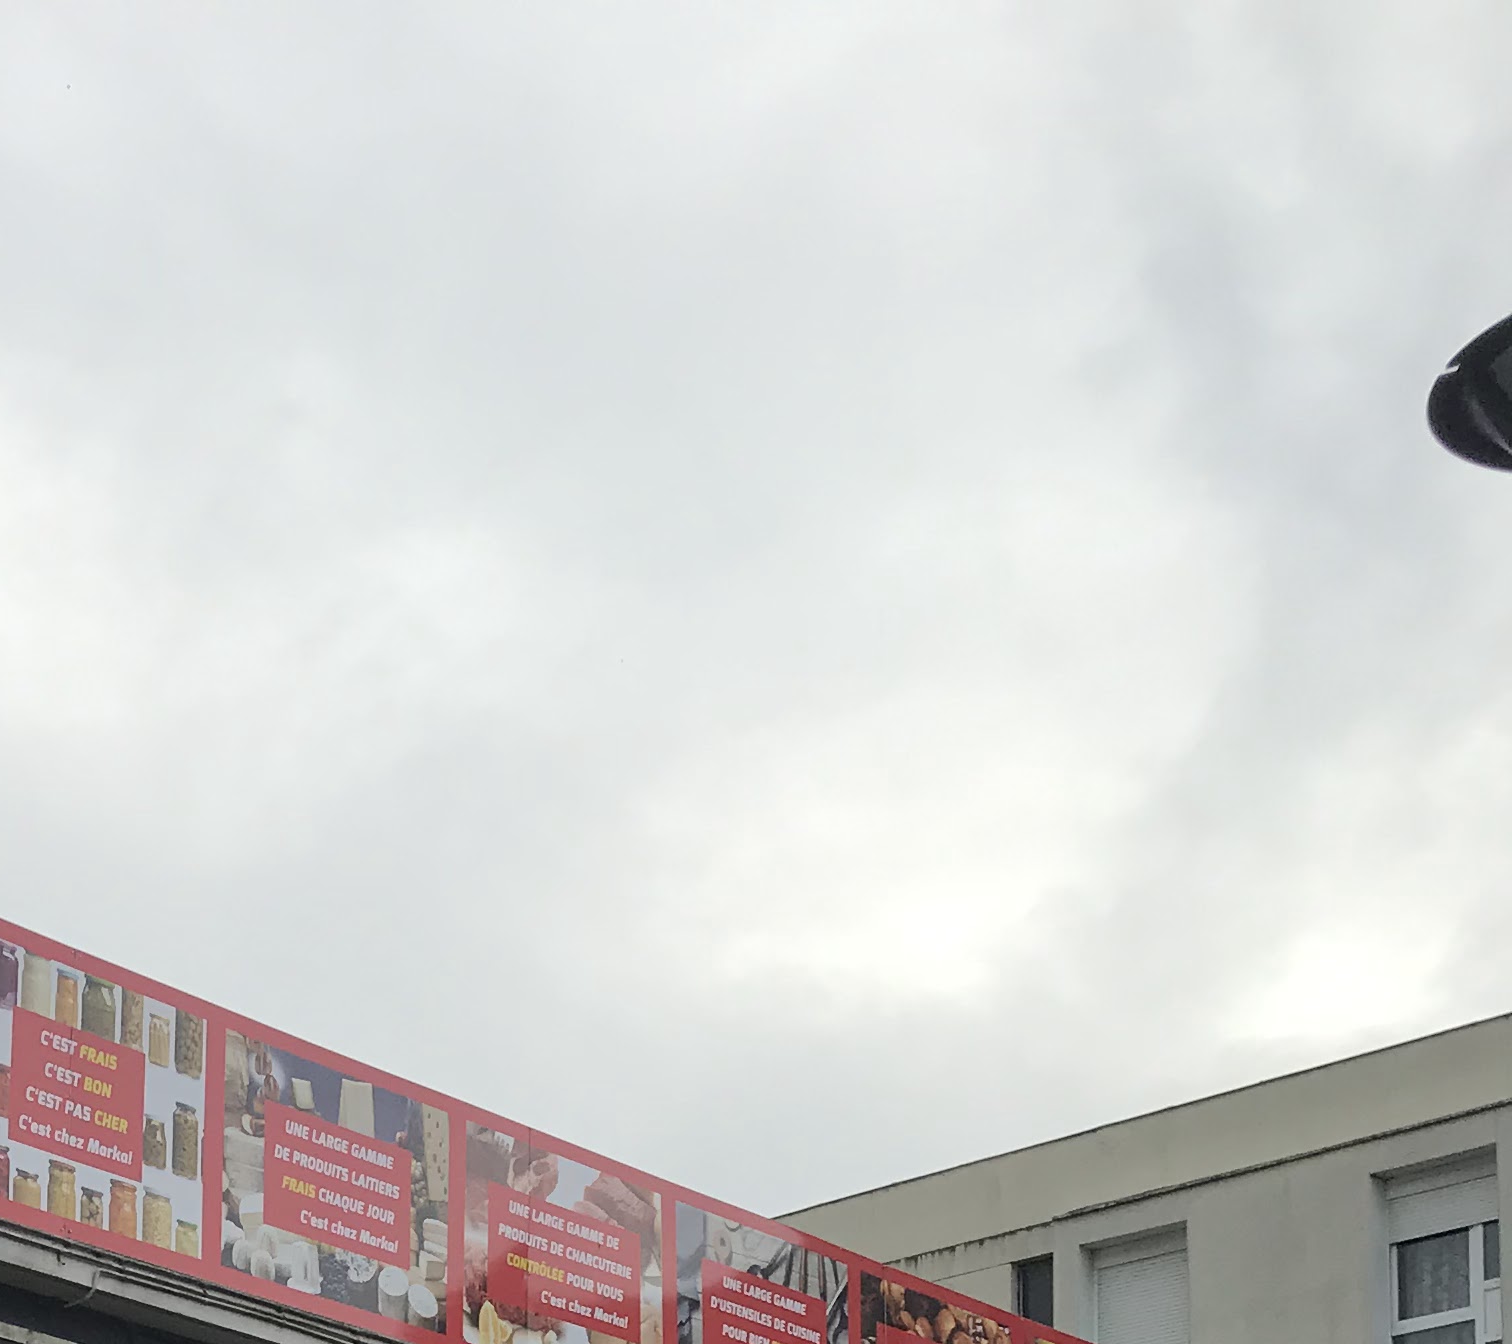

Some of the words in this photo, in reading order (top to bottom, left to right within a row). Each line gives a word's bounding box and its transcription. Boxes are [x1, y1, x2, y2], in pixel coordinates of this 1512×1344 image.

[41, 1031, 77, 1055] C'EST
[80, 1045, 118, 1070] FRAIS
[45, 1063, 81, 1087] C'EST
[84, 1077, 112, 1098] BON
[26, 1086, 63, 1110] C'EST
[65, 1100, 91, 1121] PAS
[94, 1110, 128, 1134] CHER
[19, 1115, 51, 1138] C'est
[55, 1128, 84, 1149] chez
[286, 1120, 309, 1140] UNE
[312, 1129, 349, 1154] LARGE
[351, 1144, 394, 1169] GAMME
[275, 1144, 290, 1161] DE
[293, 1151, 349, 1182] PRODUITS
[352, 1171, 400, 1199] LAITIERS
[282, 1176, 316, 1198] FRAIS
[319, 1188, 365, 1215] CHAQUE
[367, 1204, 395, 1225] JOUR
[301, 1210, 328, 1231] C'est
[331, 1221, 357, 1241] chez
[509, 1200, 530, 1219] UNE
[532, 1209, 564, 1231] LARGE
[567, 1222, 604, 1245] GAMME
[607, 1235, 619, 1250] DE
[498, 1223, 548, 1251] PRODUITS
[550, 1242, 564, 1257] DE
[566, 1247, 632, 1280] CHARCUTERIE
[541, 1291, 566, 1309] C'est
[569, 1300, 592, 1318] chez
[567, 1273, 594, 1292] POUR
[597, 1283, 623, 1302] VOUS
[723, 1276, 742, 1293] UNE
[743, 1283, 772, 1303] LARGE
[774, 1294, 806, 1316] GAMME
[711, 1296, 772, 1327] D'USTENSILES
[774, 1318, 785, 1332] DE
[787, 1323, 821, 1344] CUISINE
[722, 1324, 747, 1343] POUR
